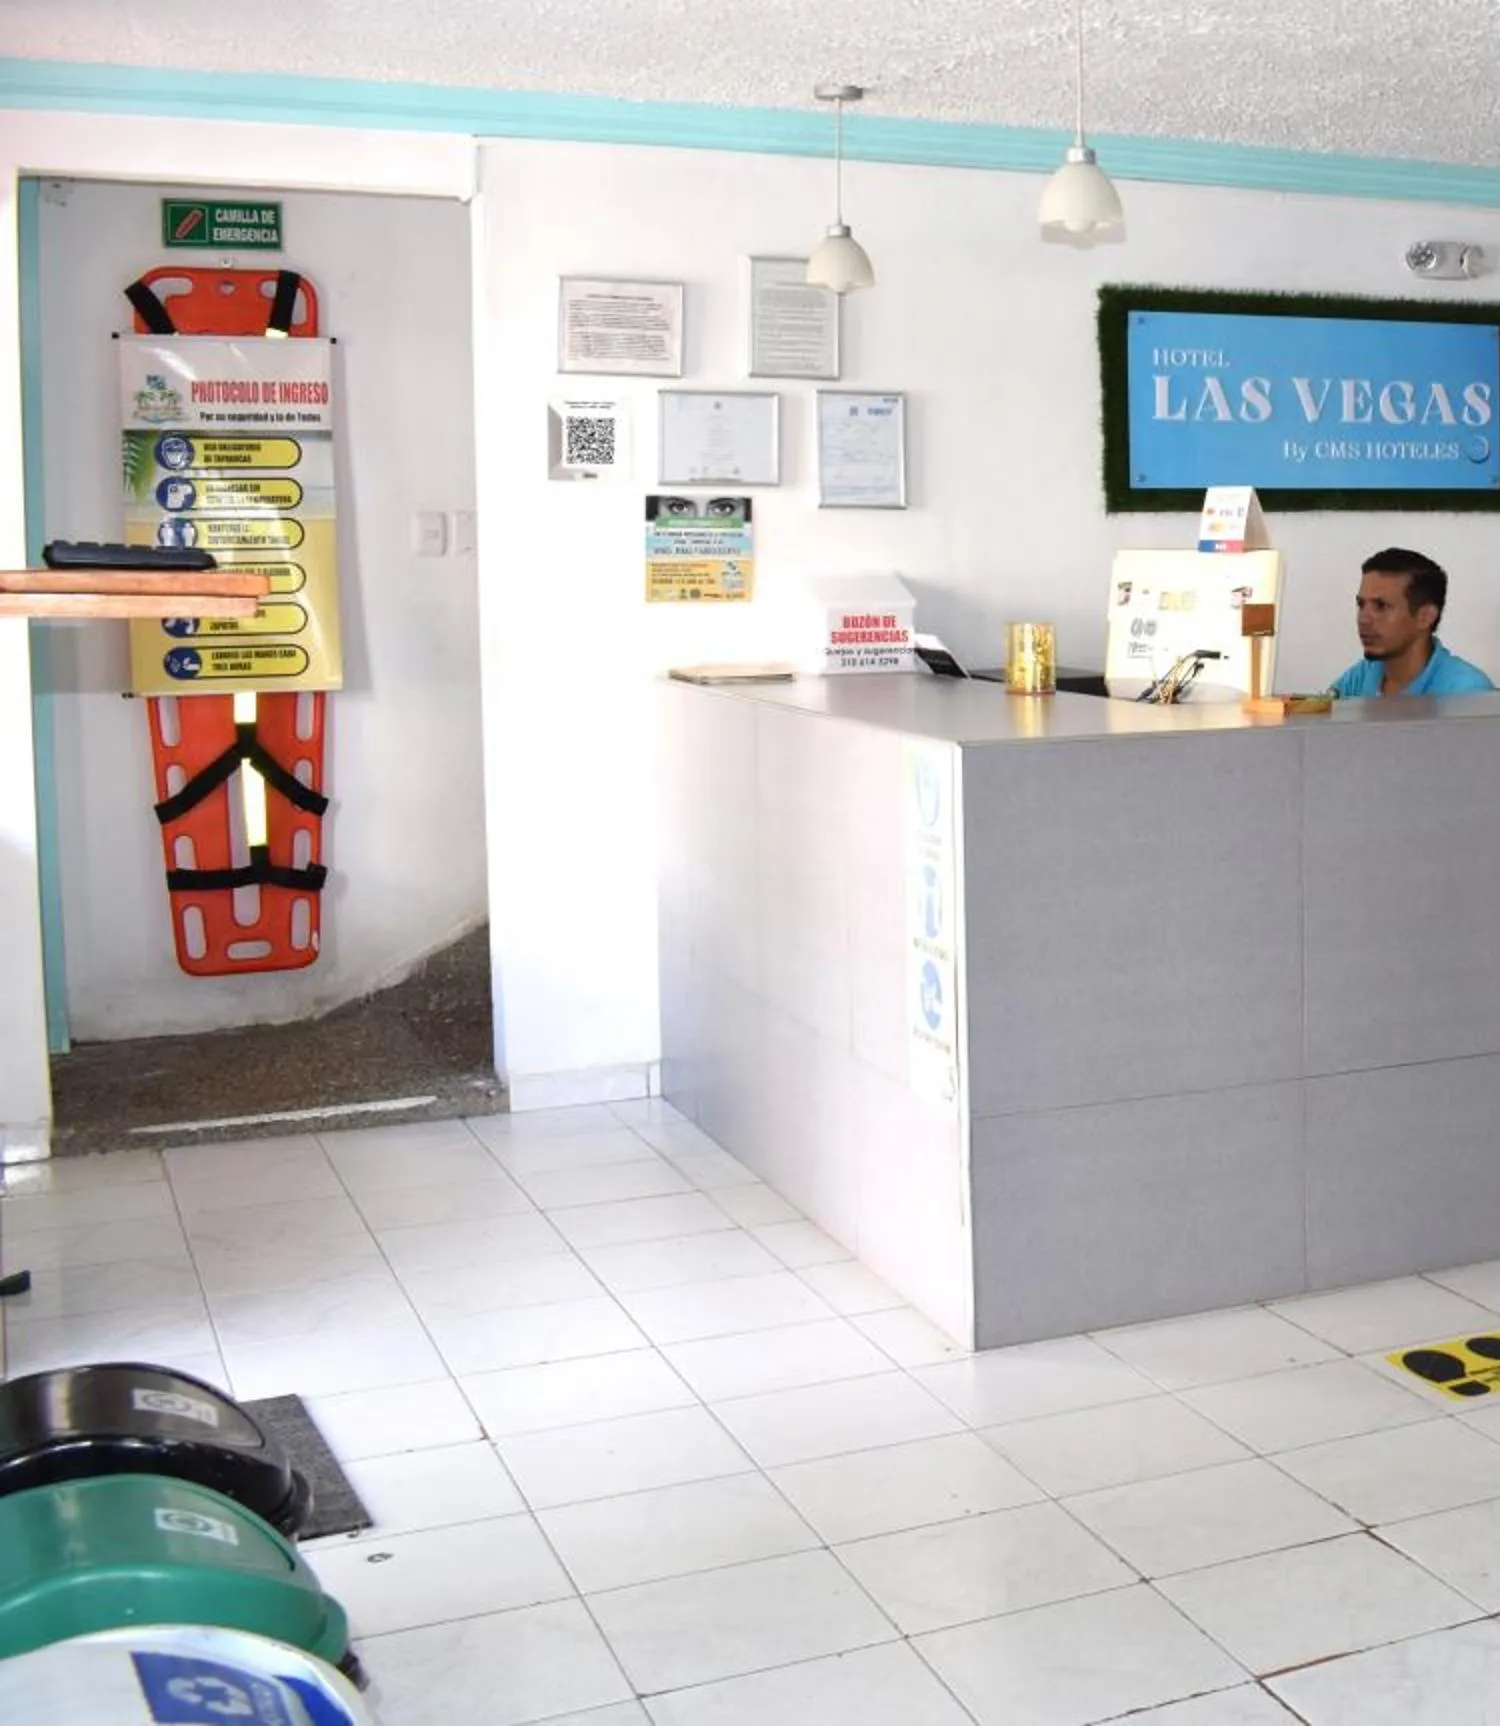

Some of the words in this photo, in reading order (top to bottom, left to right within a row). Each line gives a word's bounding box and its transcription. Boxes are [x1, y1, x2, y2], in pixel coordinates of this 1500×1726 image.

[215, 208, 259, 223] CAMILLA
[261, 210, 276, 224] DE
[212, 228, 279, 242] EMERGENCIA
[1152, 348, 1231, 368] HOTEL
[191, 380, 259, 403] PROTOCOLO
[262, 382, 277, 404] DE
[279, 382, 329, 405] INGRESO
[1151, 374, 1273, 423] LAS
[1291, 377, 1492, 427] VEGAS
[1284, 440, 1308, 463] By
[1315, 441, 1361, 460] CMS
[1366, 442, 1460, 460] HOTELES
[843, 612, 881, 628] BUZÓN
[883, 615, 897, 628] DE
[831, 629, 909, 644] SUGERENCIAS
